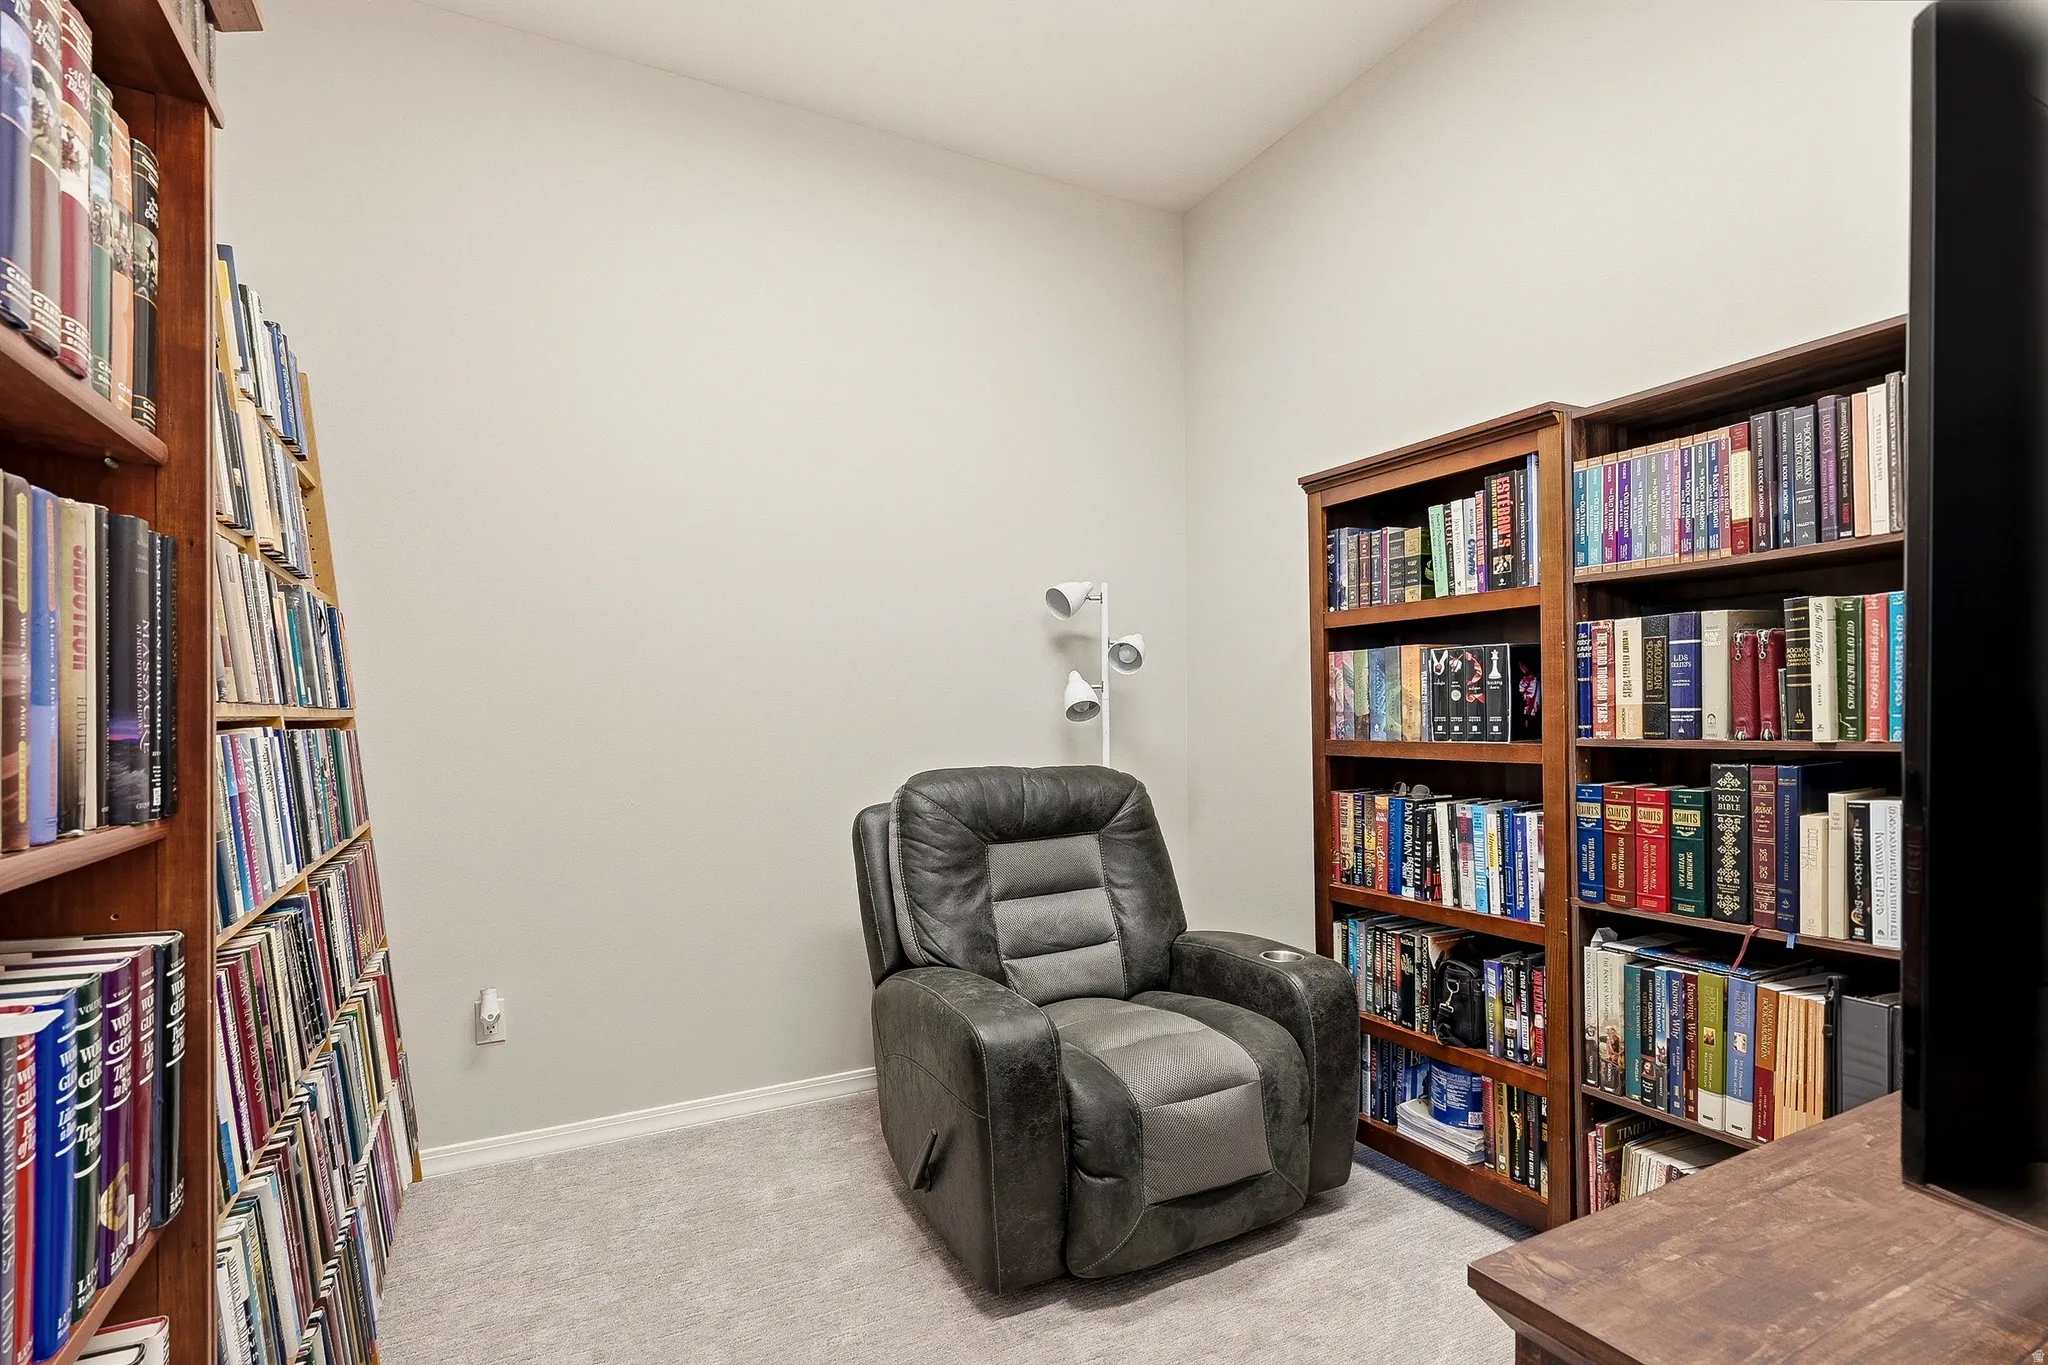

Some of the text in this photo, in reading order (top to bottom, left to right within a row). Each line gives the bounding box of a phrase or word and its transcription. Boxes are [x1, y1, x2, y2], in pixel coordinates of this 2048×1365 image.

[1822, 414, 1834, 446] RIDGES
[1795, 432, 1803, 481] STUDY GUIDE
[1804, 427, 1813, 486] BOOK MORMON
[1813, 602, 1824, 614] The
[19, 617, 28, 650] WHEN
[1814, 629, 1825, 643] 100
[1846, 620, 1855, 636] OUT
[1846, 636, 1855, 647] OF
[1653, 640, 1663, 690] MORMON
[1673, 654, 1689, 662] LDS
[1846, 664, 1855, 684] BEST
[1846, 684, 1855, 710] BOOKS
[19, 704, 28, 737] AGAIN
[1596, 702, 1609, 724] YEARS
[1717, 794, 1741, 803] HOLY
[1717, 802, 1741, 812] BIBLE
[1404, 802, 1414, 823] DAN
[1607, 806, 1629, 819] SAINTS
[1638, 809, 1662, 822] SAINTS
[1673, 811, 1698, 824] SAINTS
[1404, 823, 1414, 856] BROWN
[1474, 837, 1485, 873] QUANTUM
[1475, 875, 1486, 890] LIFE
[1421, 967, 1429, 989] JUDAS
[1669, 979, 1681, 1040] Knowing Why
[1685, 982, 1697, 1044] Knowing Why
[1760, 1023, 1768, 1060] MORMON
[1, 1076, 16, 1135] SOAR
[1595, 1136, 1604, 1175] TIMELINE
[1, 1185, 16, 1276] EAGLES
